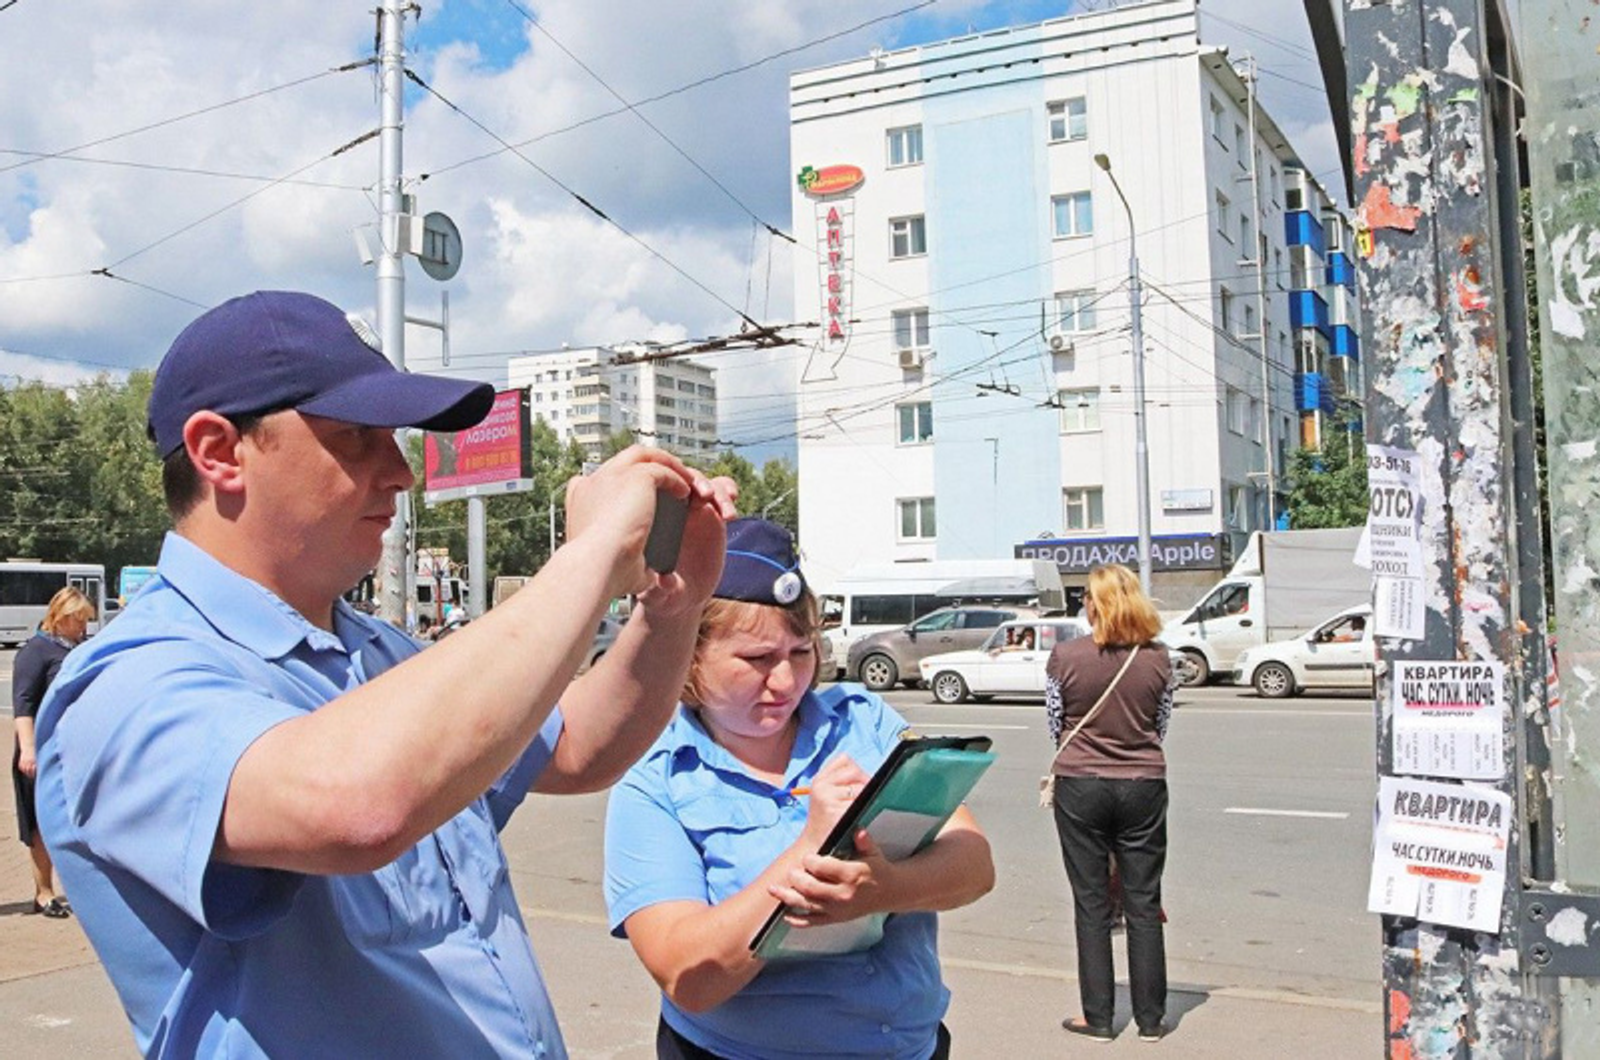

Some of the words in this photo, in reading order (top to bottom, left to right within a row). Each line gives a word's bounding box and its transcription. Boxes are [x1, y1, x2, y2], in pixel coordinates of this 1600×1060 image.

[826, 206, 845, 343] АПТЕКА
[1151, 542, 1215, 565] Apple
[1404, 666, 1494, 680] КВАРТИРА
[1394, 790, 1503, 828] КВАРТИРА
